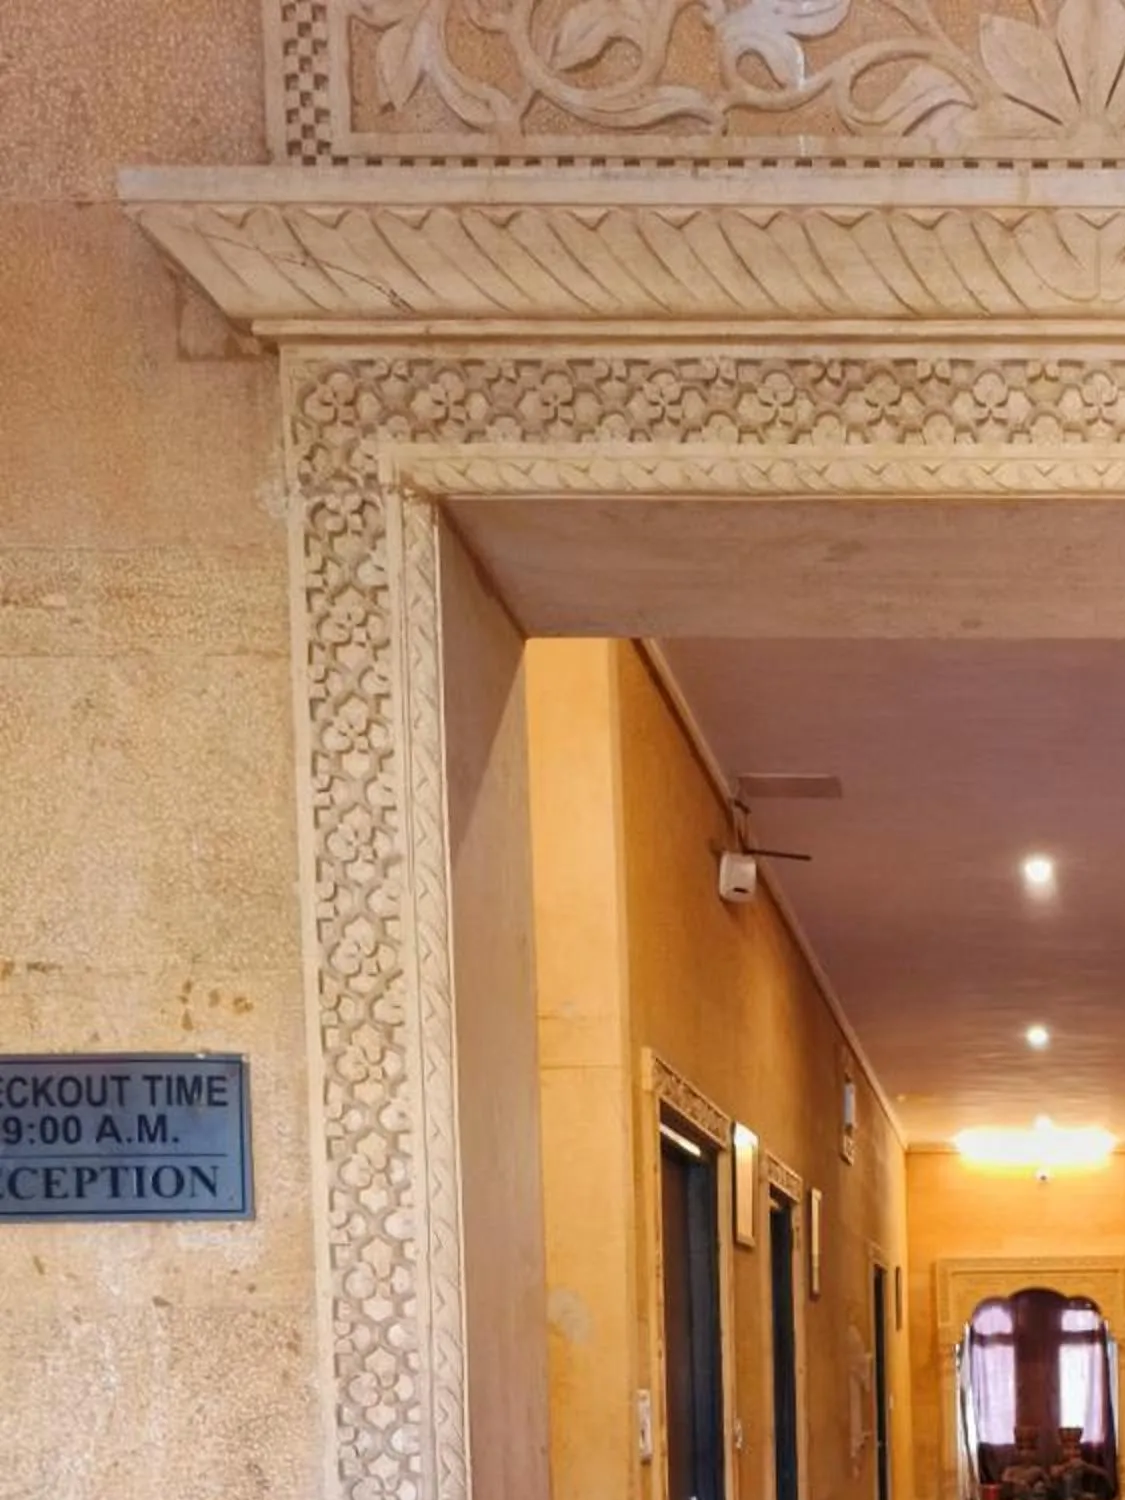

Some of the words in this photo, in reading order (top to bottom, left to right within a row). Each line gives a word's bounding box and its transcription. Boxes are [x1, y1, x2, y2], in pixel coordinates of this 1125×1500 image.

[0, 1075, 130, 1107] CKOUT
[142, 1075, 229, 1107] TIME
[2, 1115, 82, 1145] 9:00
[95, 1113, 180, 1144] A.M.
[0, 1165, 220, 1200] CEPTION
